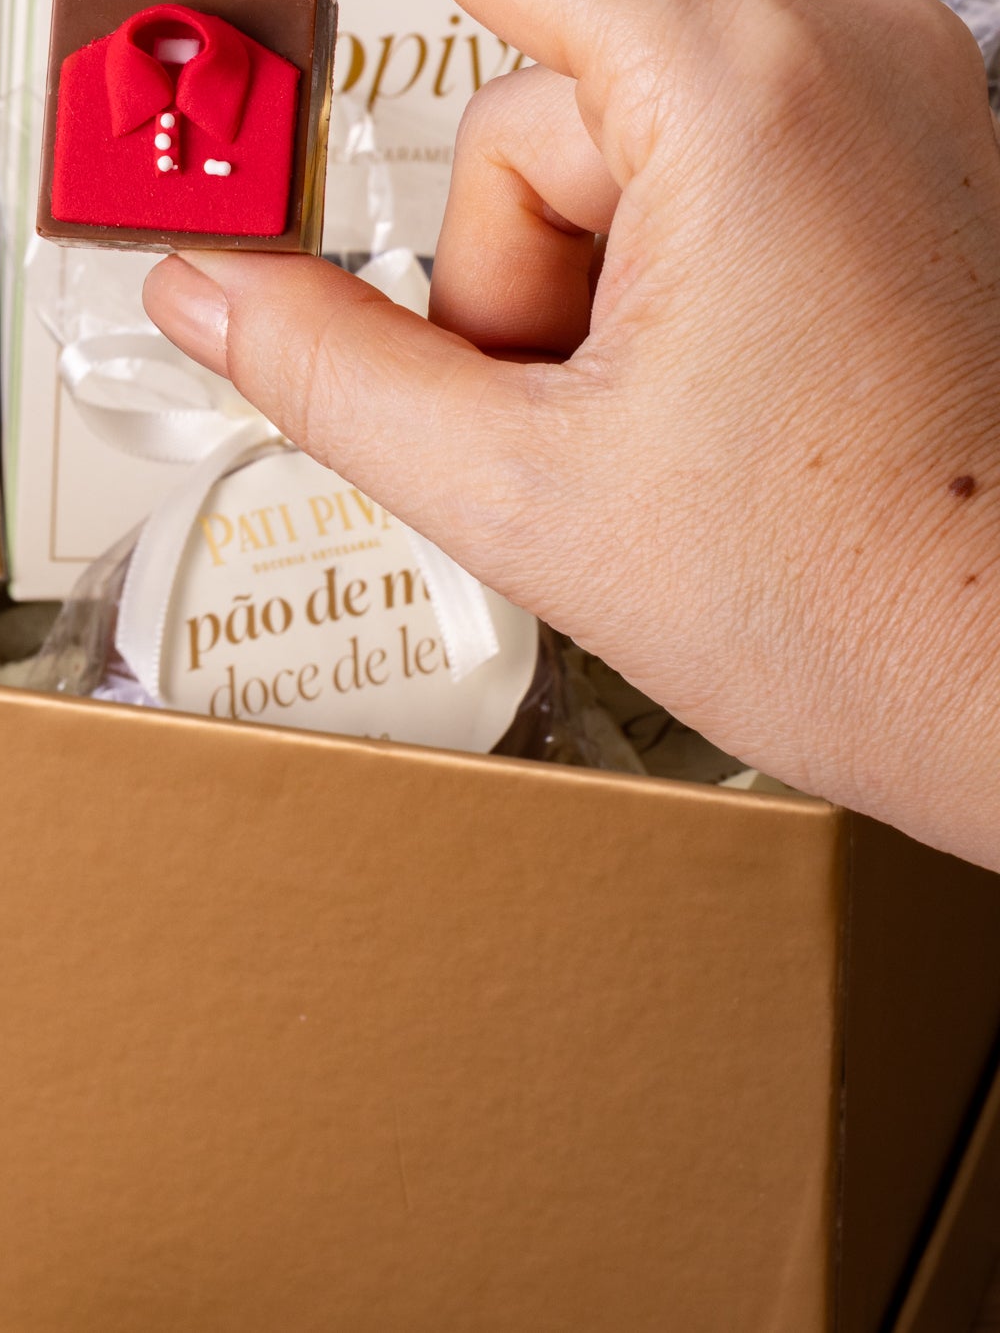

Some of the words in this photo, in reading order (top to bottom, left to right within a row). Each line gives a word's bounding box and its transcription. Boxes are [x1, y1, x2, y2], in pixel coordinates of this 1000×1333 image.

[201, 498, 298, 566] PATI
[185, 593, 294, 672] pão
[306, 566, 371, 626] de
[381, 567, 432, 610] m
[209, 666, 323, 722] doce
[333, 635, 391, 693] de
[397, 624, 451, 680] le
